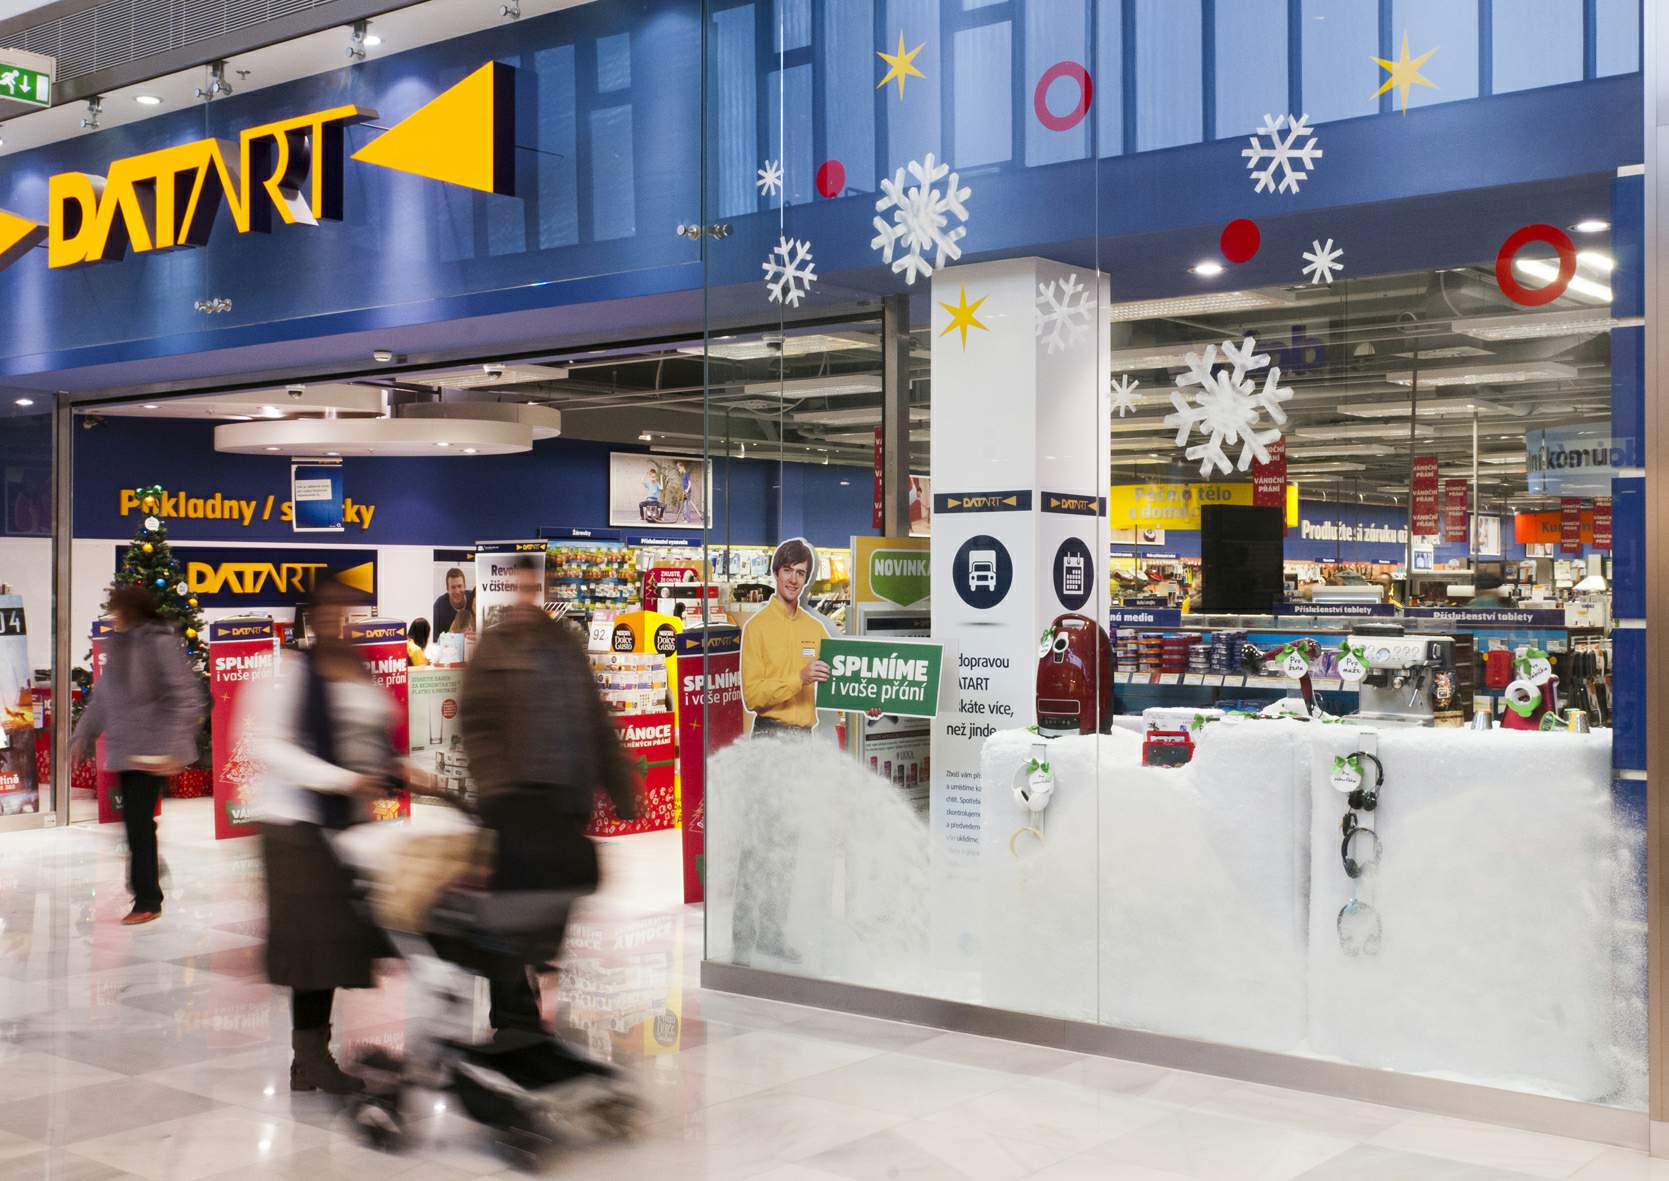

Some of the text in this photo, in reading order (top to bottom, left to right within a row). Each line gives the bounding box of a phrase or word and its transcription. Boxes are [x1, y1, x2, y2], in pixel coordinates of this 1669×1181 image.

[48, 104, 357, 269] DATART
[963, 496, 1003, 508] DATART
[187, 561, 329, 594] DATART
[1294, 601, 1372, 614] Příslušenství tablety
[1124, 612, 1154, 622] media
[1433, 611, 1534, 623] Příslušenství tablety
[363, 656, 407, 674] PLNÍME
[831, 652, 929, 682] SPLNÍME
[223, 669, 249, 681] vaše
[386, 671, 407, 688] přání
[683, 668, 741, 692] SPLNÍM
[722, 687, 742, 705] přán
[831, 678, 927, 704] i vaše přání
[958, 698, 1014, 718] káte více,
[946, 722, 997, 740] než jinde
